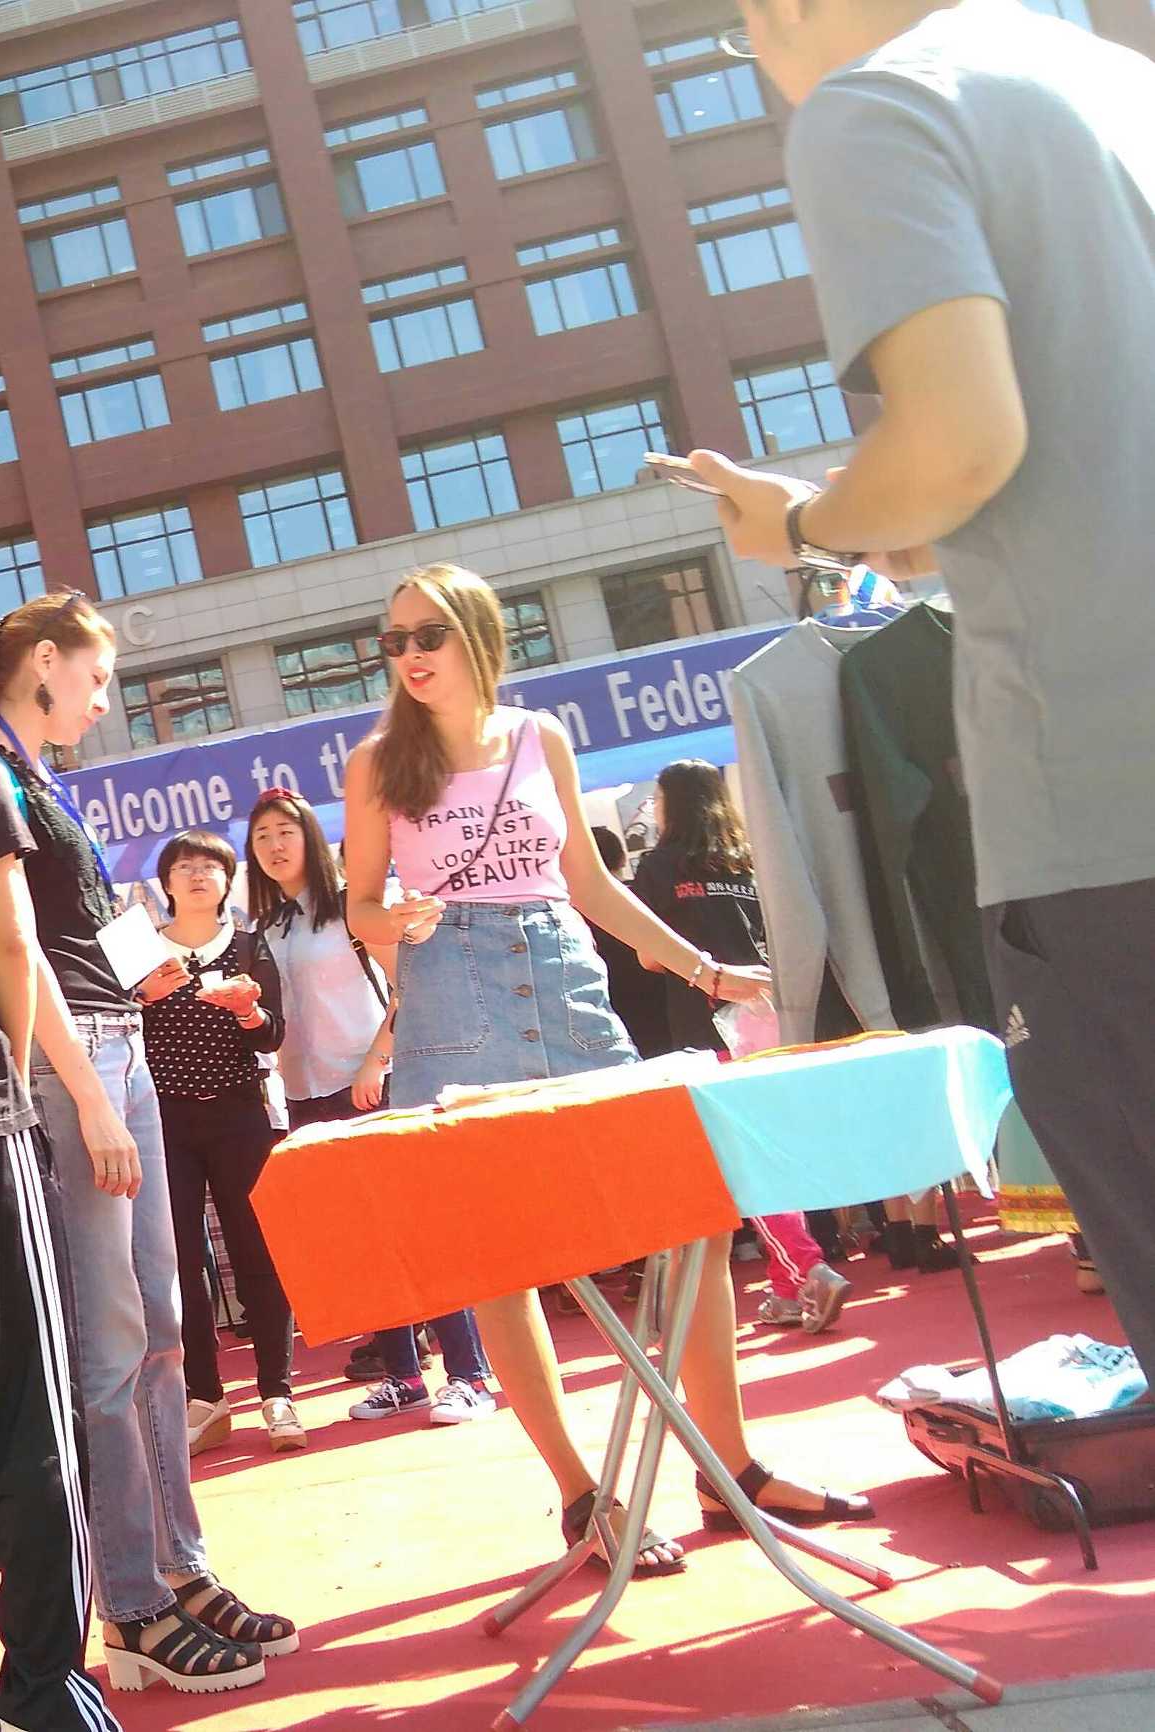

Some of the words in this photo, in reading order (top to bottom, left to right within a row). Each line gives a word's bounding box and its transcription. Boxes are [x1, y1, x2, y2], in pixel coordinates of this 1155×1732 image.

[121, 604, 157, 646] C
[72, 774, 233, 844] elcome
[251, 756, 300, 794] to
[408, 805, 485, 833] TRAIN
[462, 815, 533, 841] BEAST
[495, 837, 547, 857] LIKE
